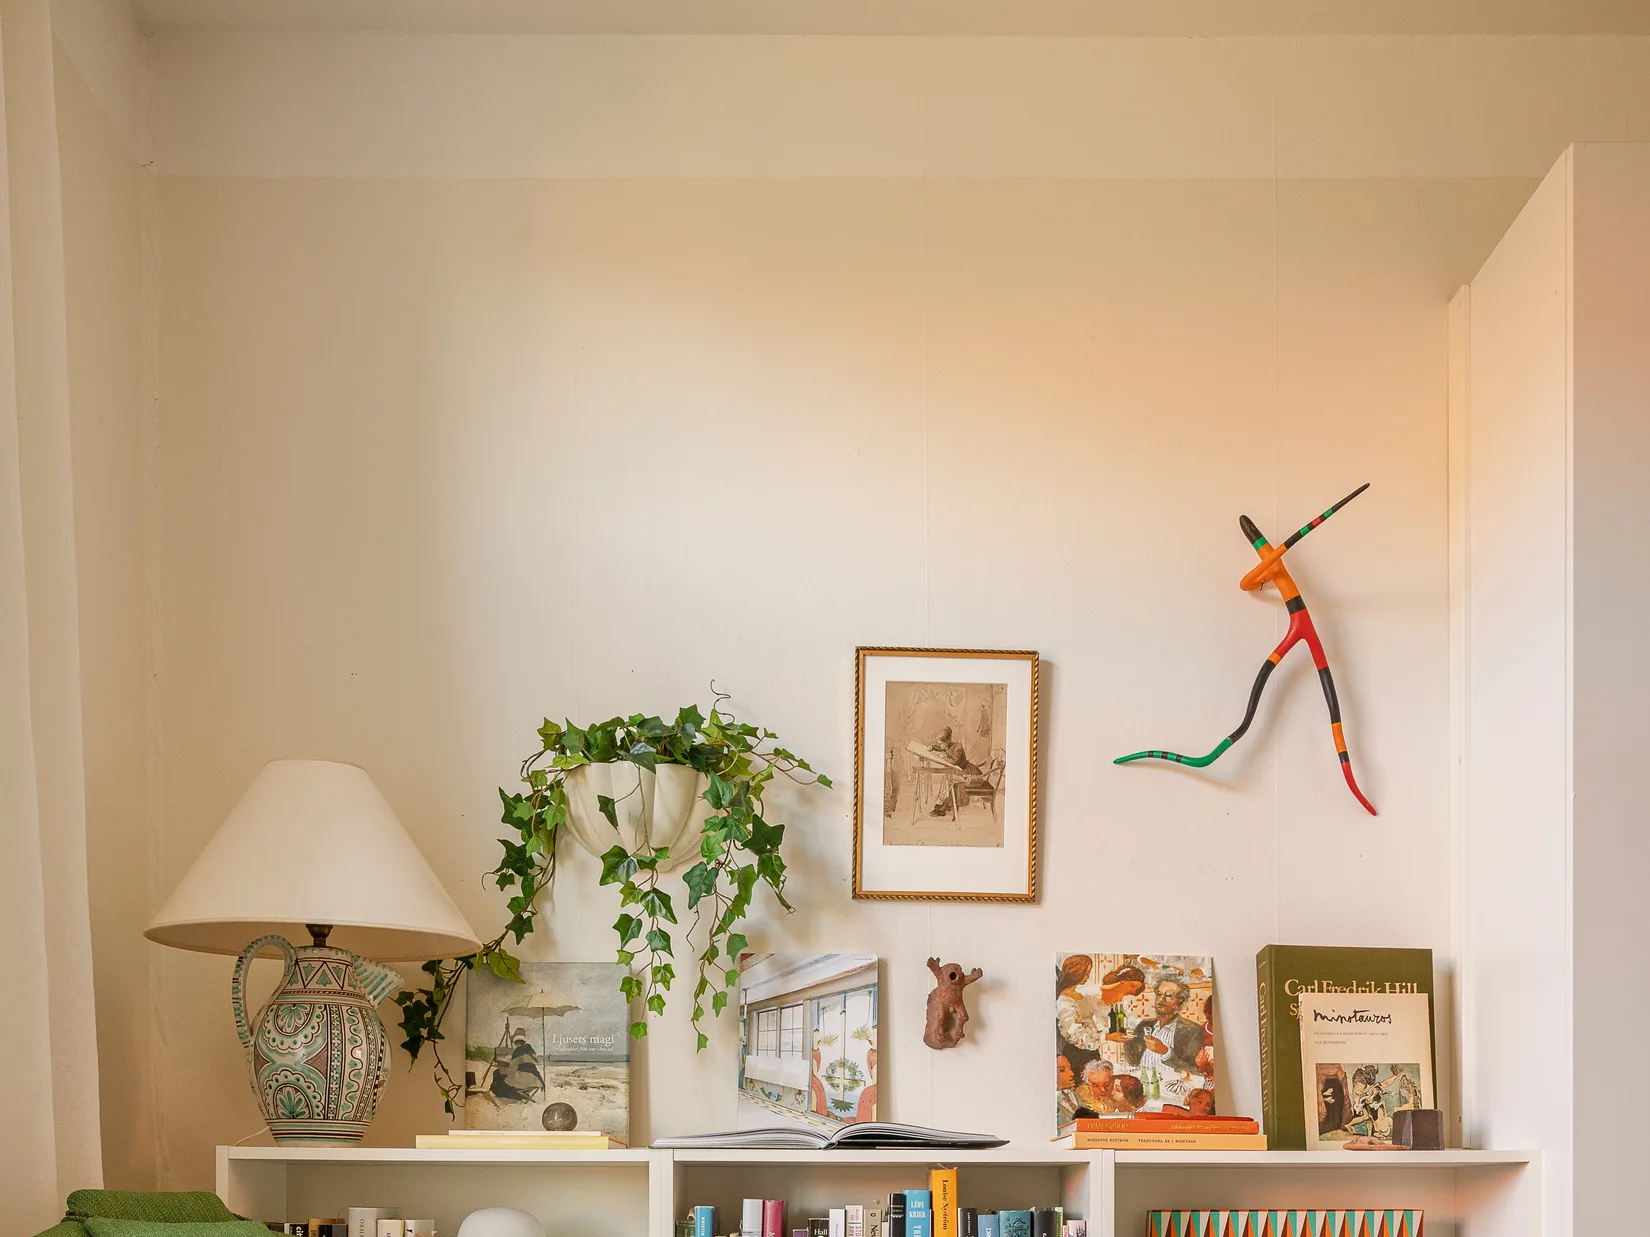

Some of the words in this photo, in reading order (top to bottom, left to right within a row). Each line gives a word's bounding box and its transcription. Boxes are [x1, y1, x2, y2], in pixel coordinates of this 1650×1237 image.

[1284, 978, 1318, 997] Carl
[1322, 980, 1382, 993] Fredrik
[1383, 981, 1417, 994] Hill
[552, 1034, 587, 1046] Ljusets
[590, 1034, 614, 1047] magi
[940, 1203, 949, 1230] Nyström
